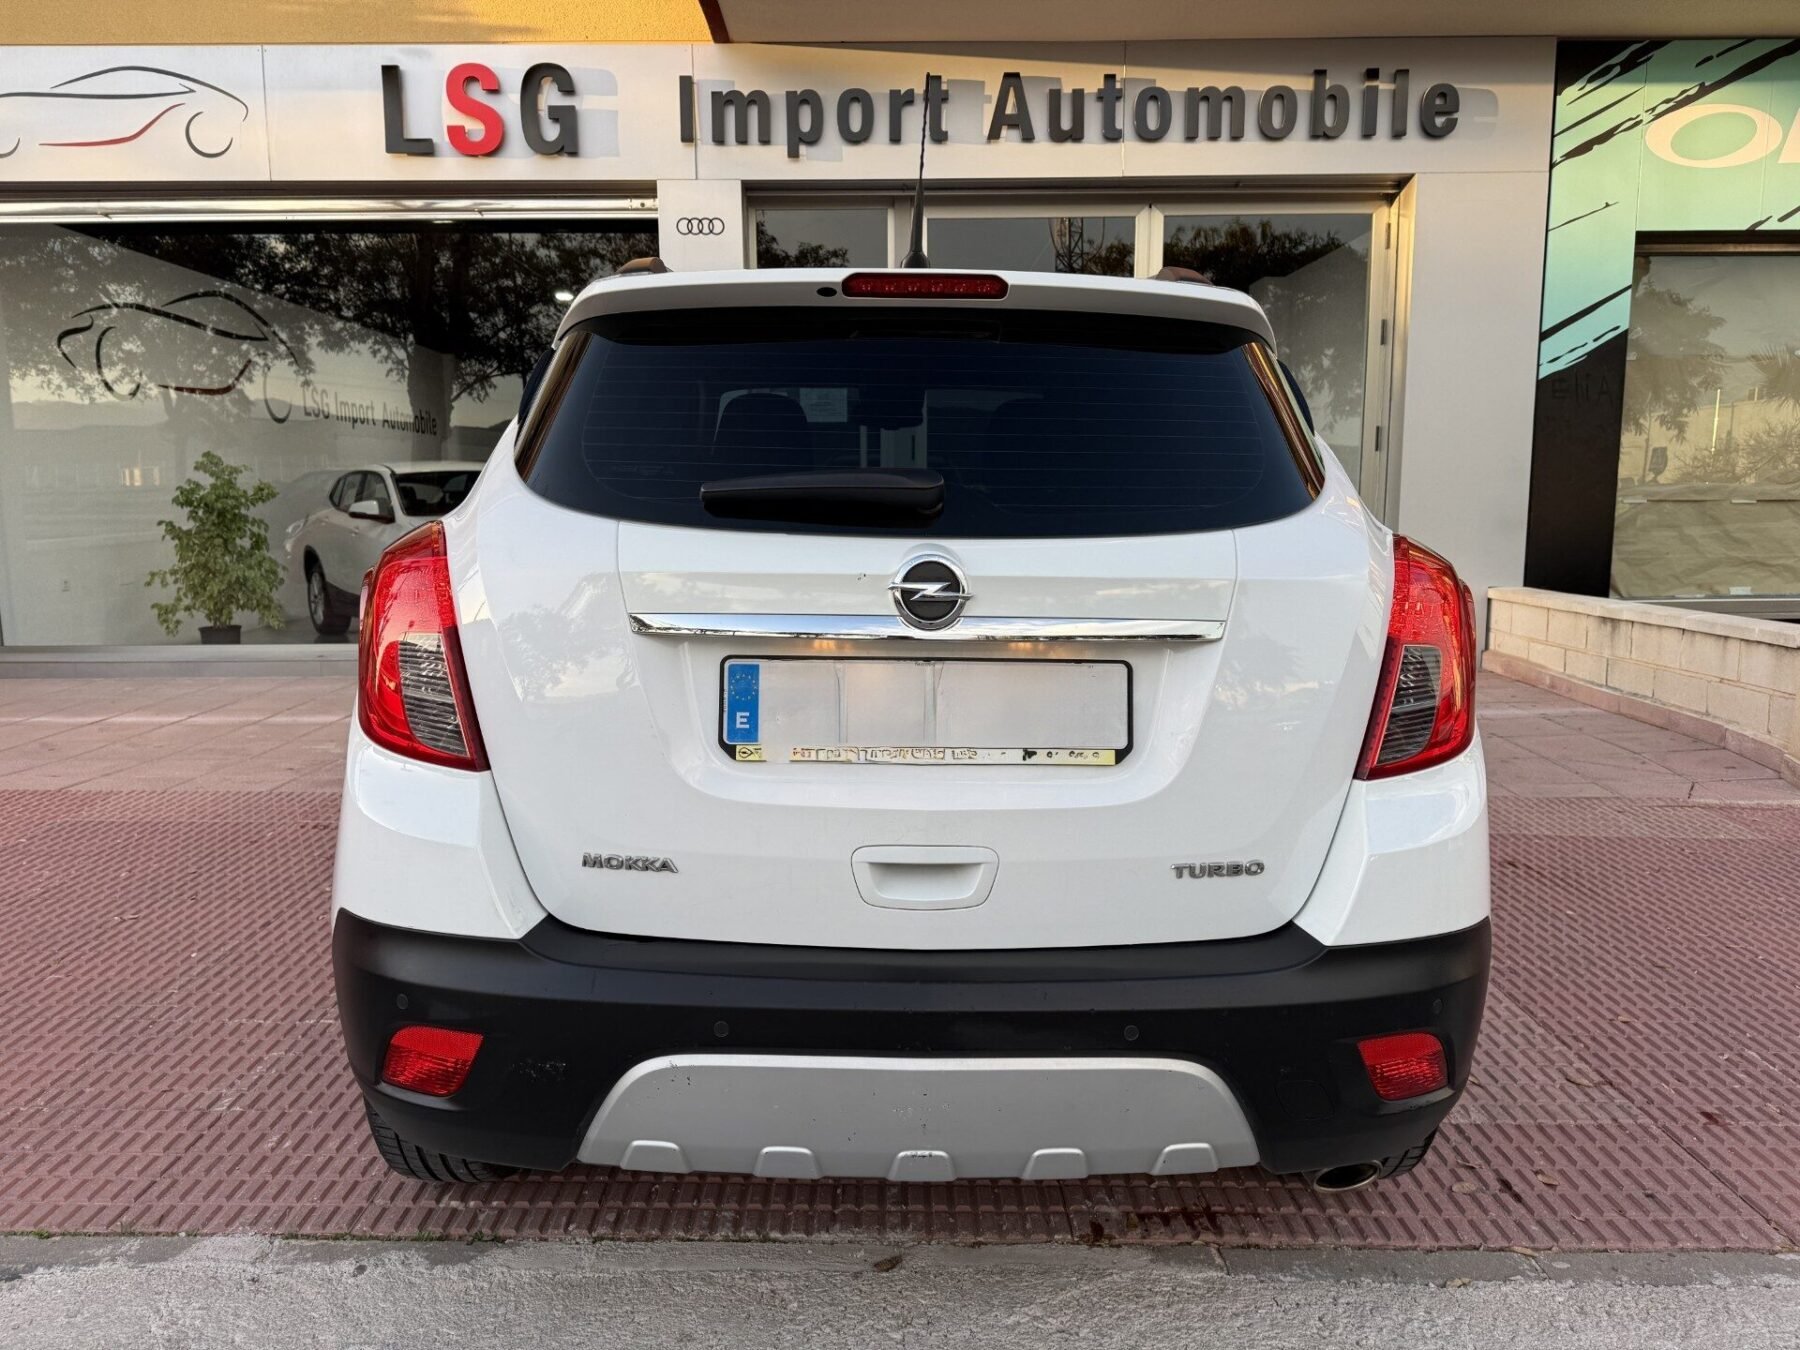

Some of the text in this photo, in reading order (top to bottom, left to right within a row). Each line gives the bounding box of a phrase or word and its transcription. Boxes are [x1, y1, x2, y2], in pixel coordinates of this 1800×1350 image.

[380, 63, 1460, 159] LSG Import Automobile
[1645, 104, 1800, 169] O
[302, 385, 438, 436] LSG Import Automobile
[735, 711, 750, 729] E
[581, 852, 679, 874] MOKKA
[1170, 858, 1265, 880] TURBO
